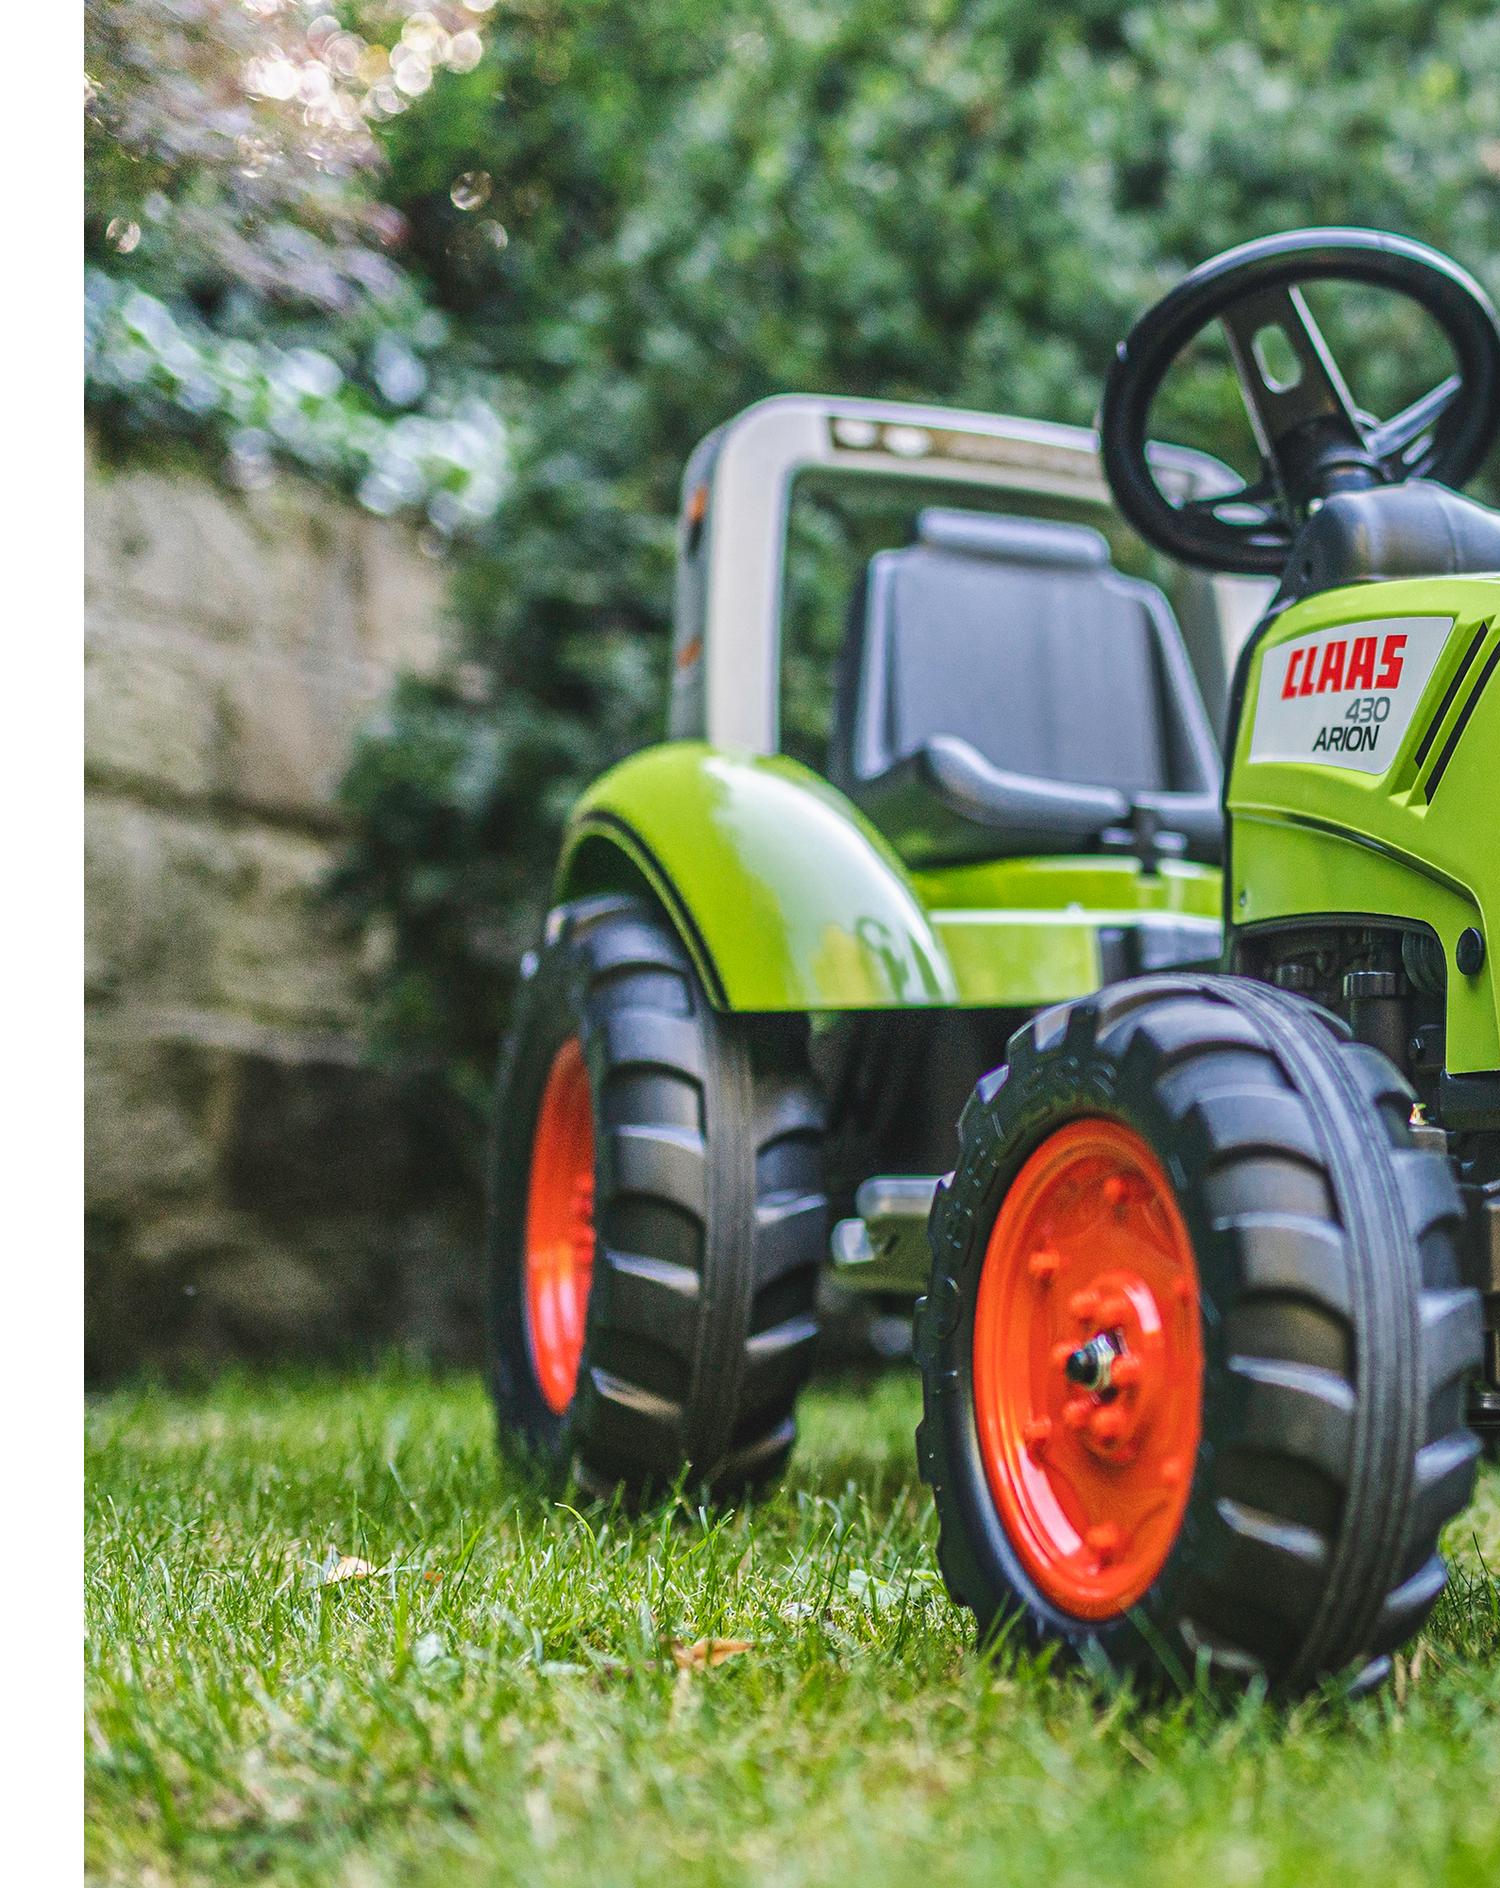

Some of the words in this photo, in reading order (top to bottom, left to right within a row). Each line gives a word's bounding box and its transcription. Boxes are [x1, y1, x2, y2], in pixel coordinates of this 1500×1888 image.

[1281, 634, 1408, 700] CLAAS
[1345, 696, 1391, 723] 430
[1312, 725, 1381, 751] ARION
